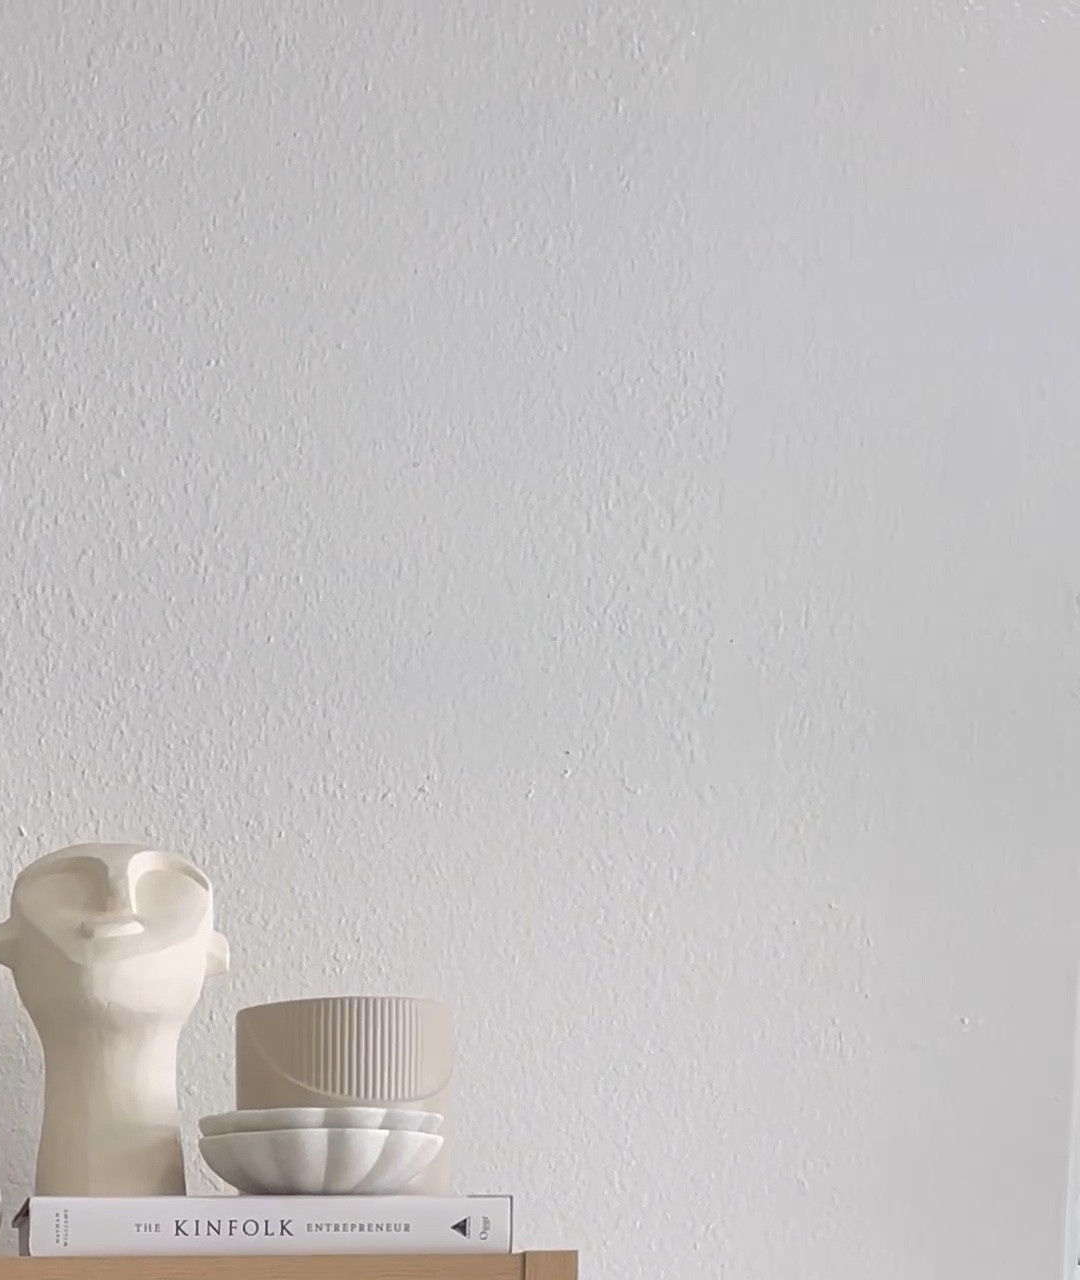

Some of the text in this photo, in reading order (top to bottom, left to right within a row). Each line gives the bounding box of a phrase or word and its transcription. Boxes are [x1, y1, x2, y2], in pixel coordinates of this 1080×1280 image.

[134, 1218, 411, 1237] THE KINFOLK ENTREPRENEUR
